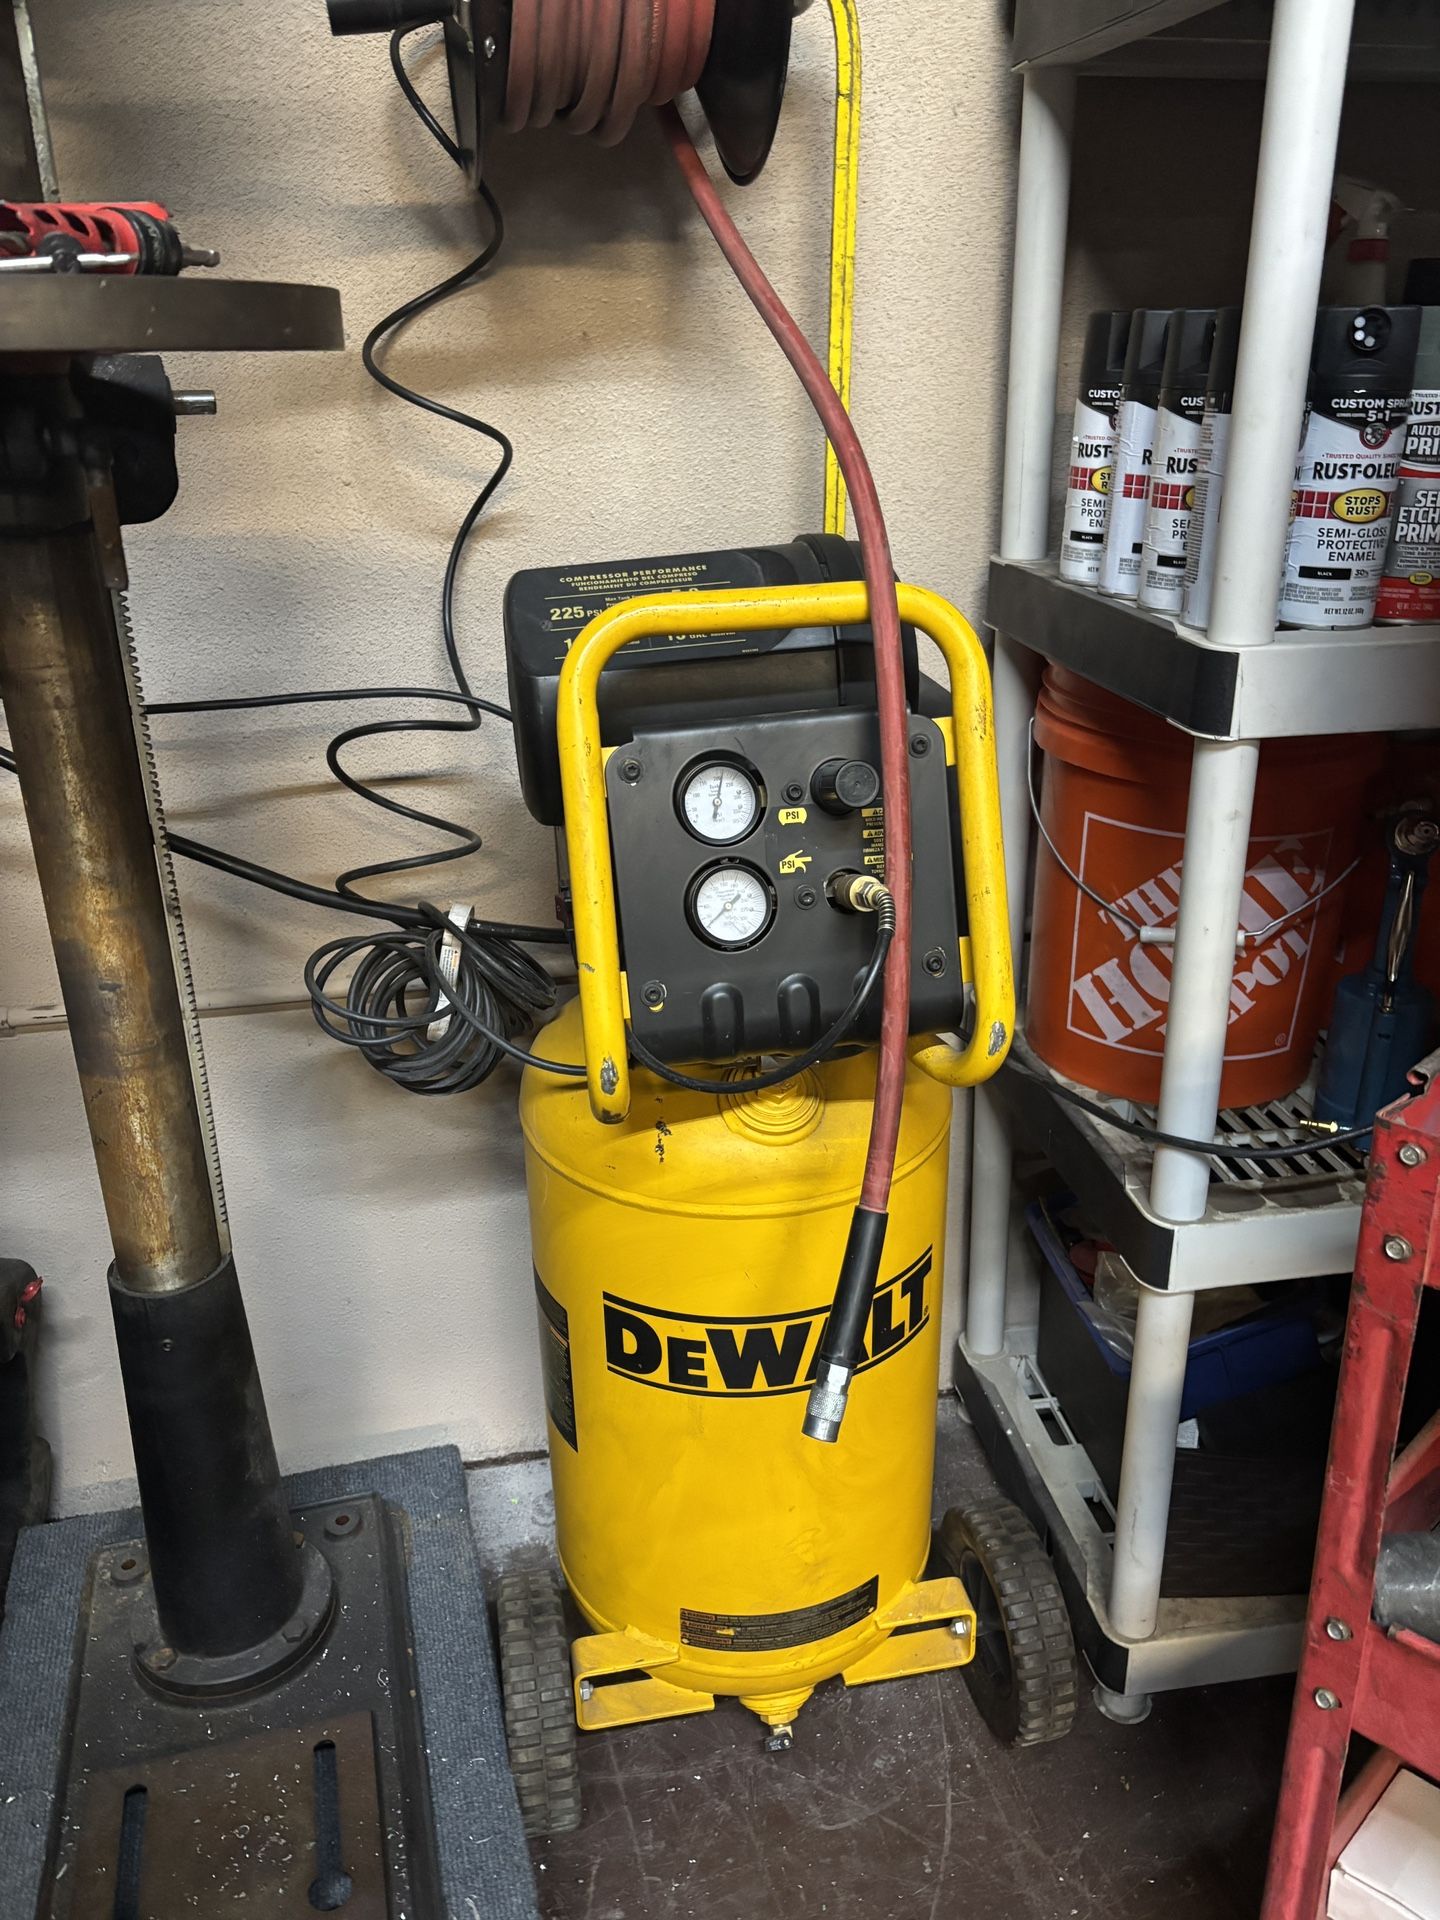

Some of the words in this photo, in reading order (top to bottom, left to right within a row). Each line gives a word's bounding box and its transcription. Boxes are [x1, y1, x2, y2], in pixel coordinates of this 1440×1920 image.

[1088, 389, 1120, 399] CUSTO
[1331, 398, 1385, 409] CUSTOM
[1411, 424, 1440, 436] AUTO
[1345, 496, 1381, 506] STOPS
[1346, 506, 1376, 516] RUST
[1089, 518, 1105, 528] EN
[1328, 551, 1376, 562] ENAMEL
[559, 572, 628, 583] COMPRESSOR
[633, 564, 707, 577] PERFORMANCE
[578, 583, 624, 592] RENDEMENT
[639, 577, 693, 586] COMPRESSEUR
[551, 606, 585, 621] 225
[786, 811, 799, 820] PSI
[782, 861, 795, 870] PSI
